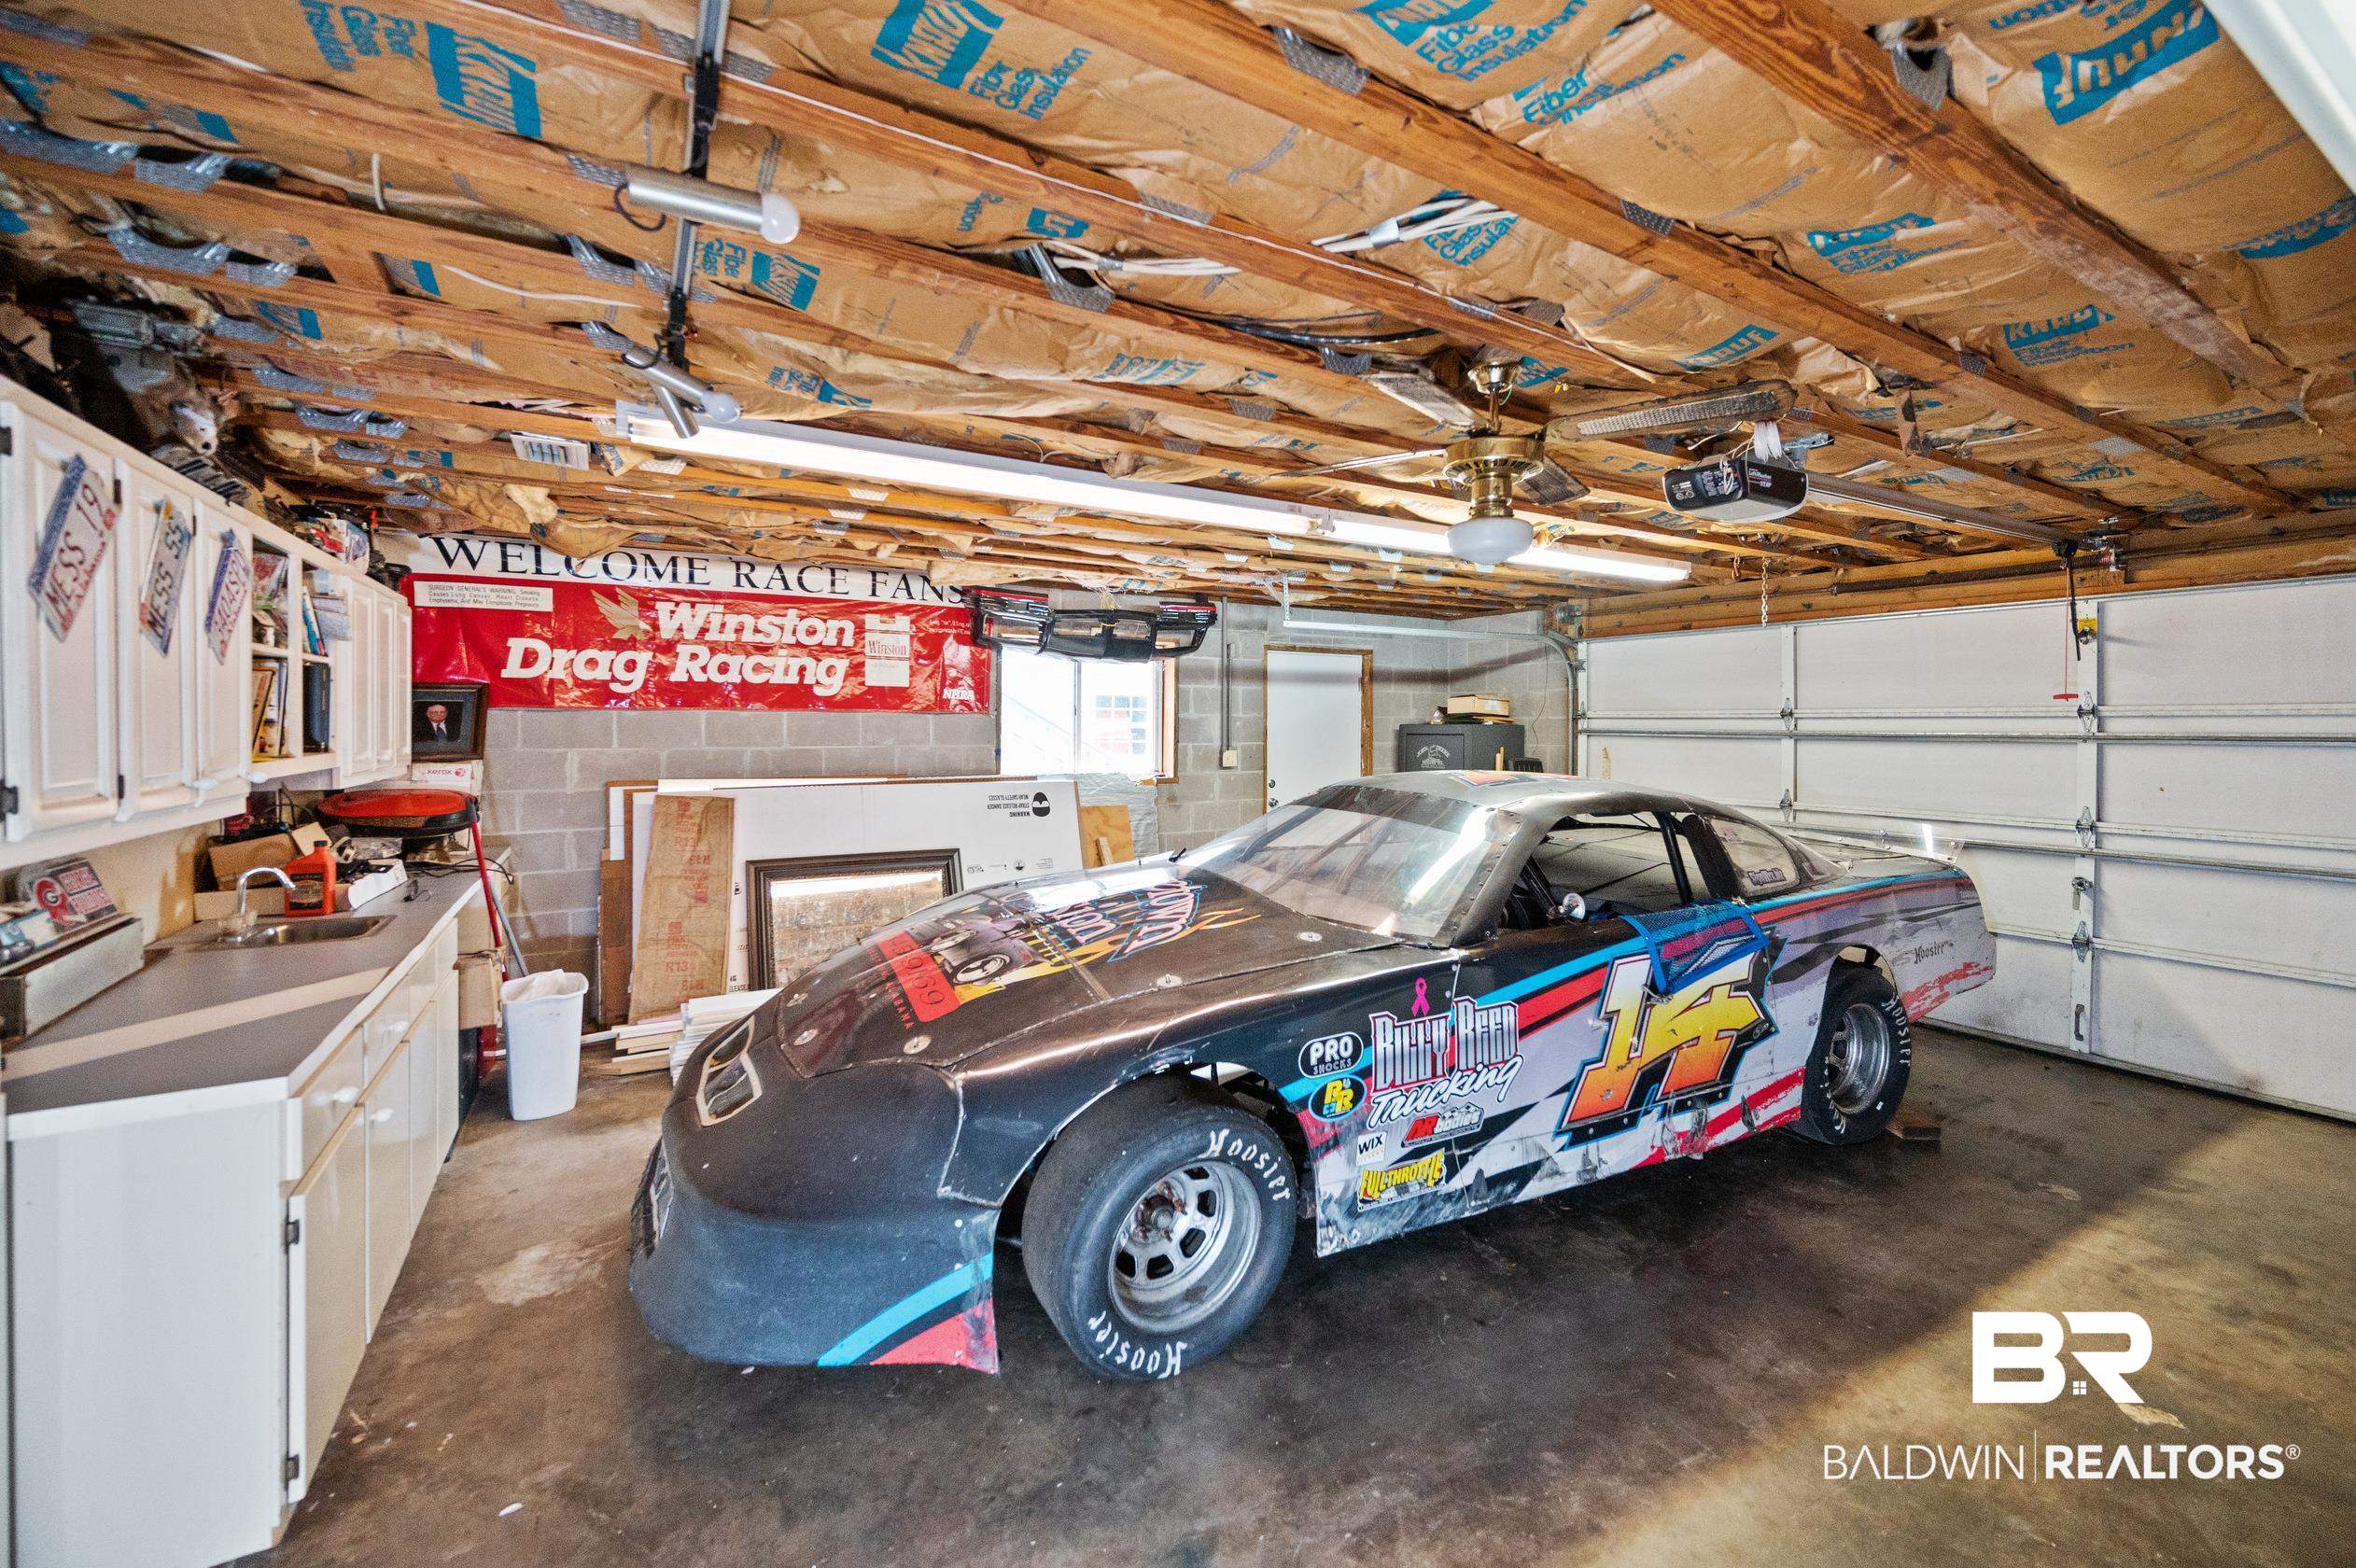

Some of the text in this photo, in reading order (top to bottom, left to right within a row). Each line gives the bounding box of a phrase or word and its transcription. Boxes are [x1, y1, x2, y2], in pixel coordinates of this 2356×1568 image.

[732, 559, 850, 595] RACE
[654, 601, 855, 647] Winston
[868, 639, 907, 655] Winston
[500, 637, 850, 697] Drag Racing
[1309, 1035, 1354, 1066] PRO
[1371, 999, 1519, 1092] BILLY REED
[1562, 950, 1765, 1130] 14
[1312, 1058, 1352, 1075] SHOCKS
[1367, 1054, 1524, 1128] Trucking
[1199, 1128, 1291, 1201] Hoosier
[1358, 1133, 1383, 1155] WIX
